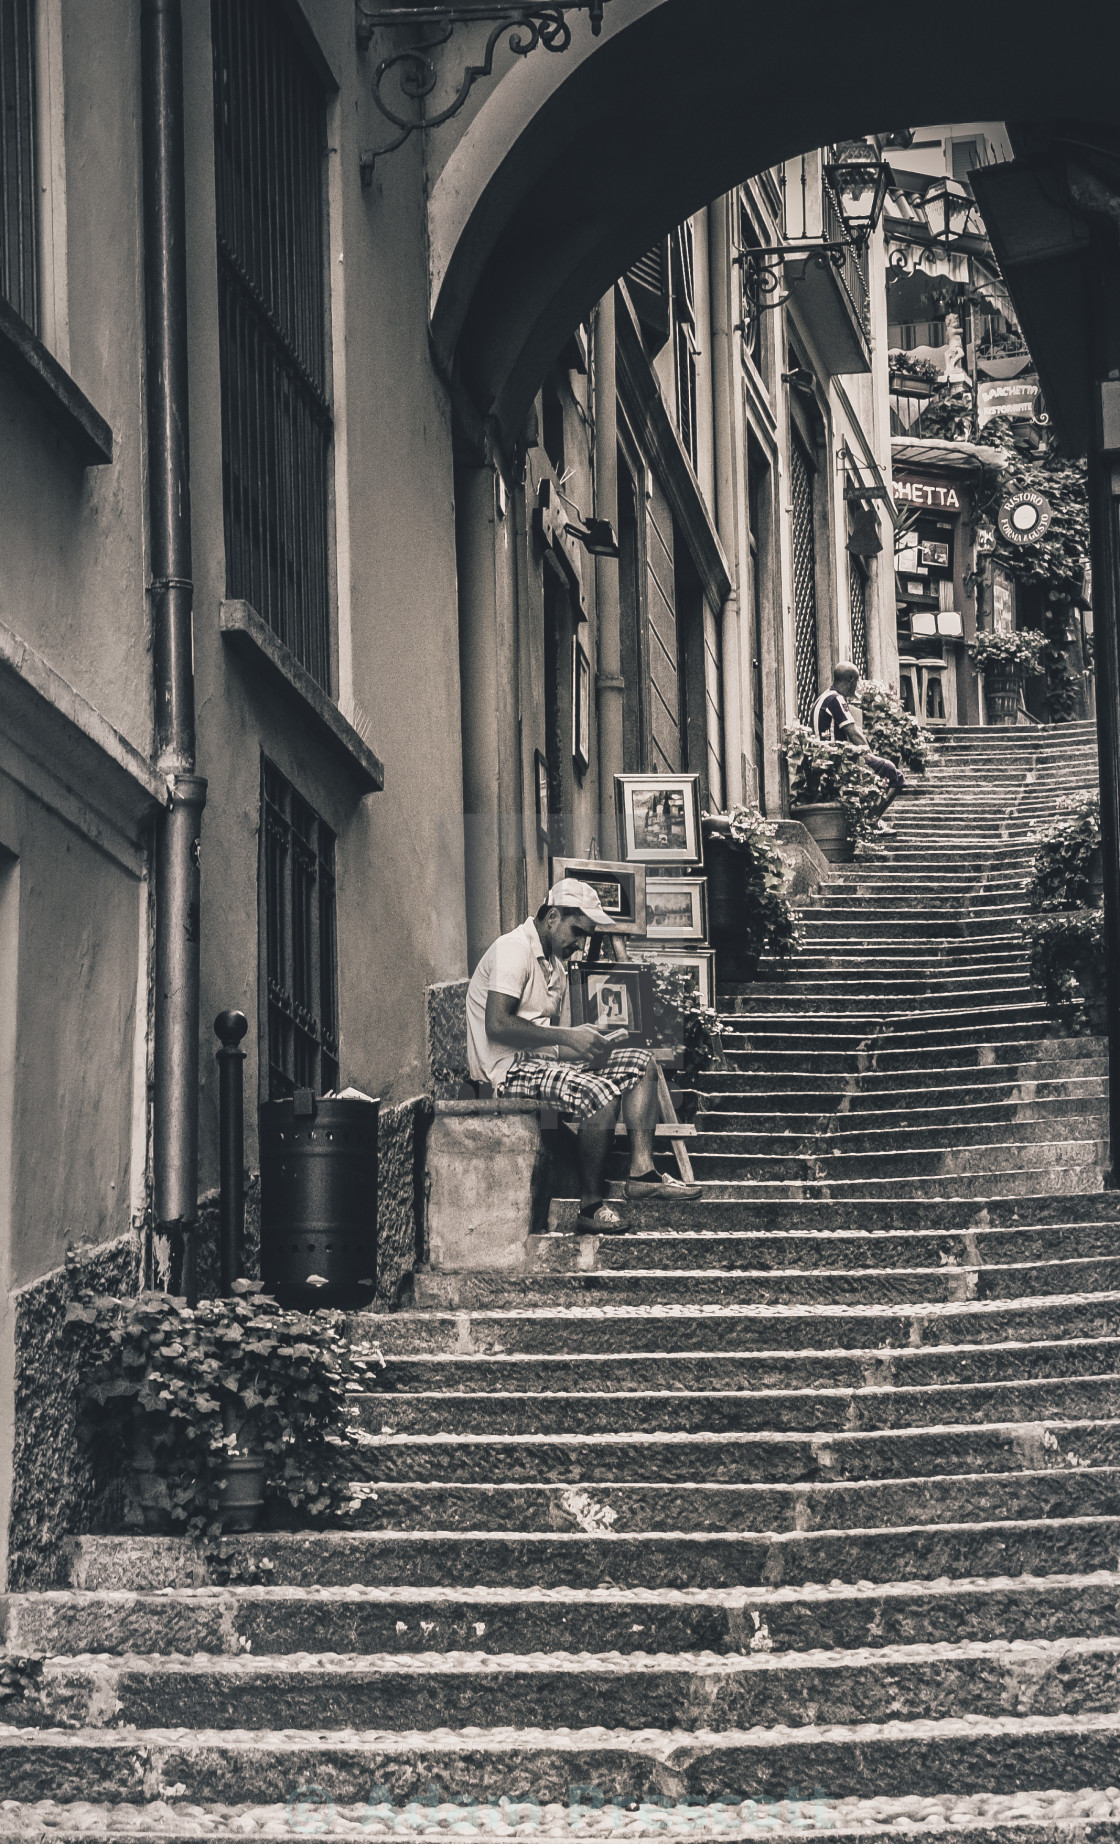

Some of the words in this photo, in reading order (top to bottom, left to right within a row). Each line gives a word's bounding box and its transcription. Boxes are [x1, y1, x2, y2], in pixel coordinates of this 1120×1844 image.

[982, 384, 1038, 402] BARCHETTA
[984, 402, 1033, 415] RISTORANTE
[1003, 492, 1043, 511] RISTORO
[1001, 518, 1022, 542] FORMA
[1028, 513, 1049, 540] GUSTO
